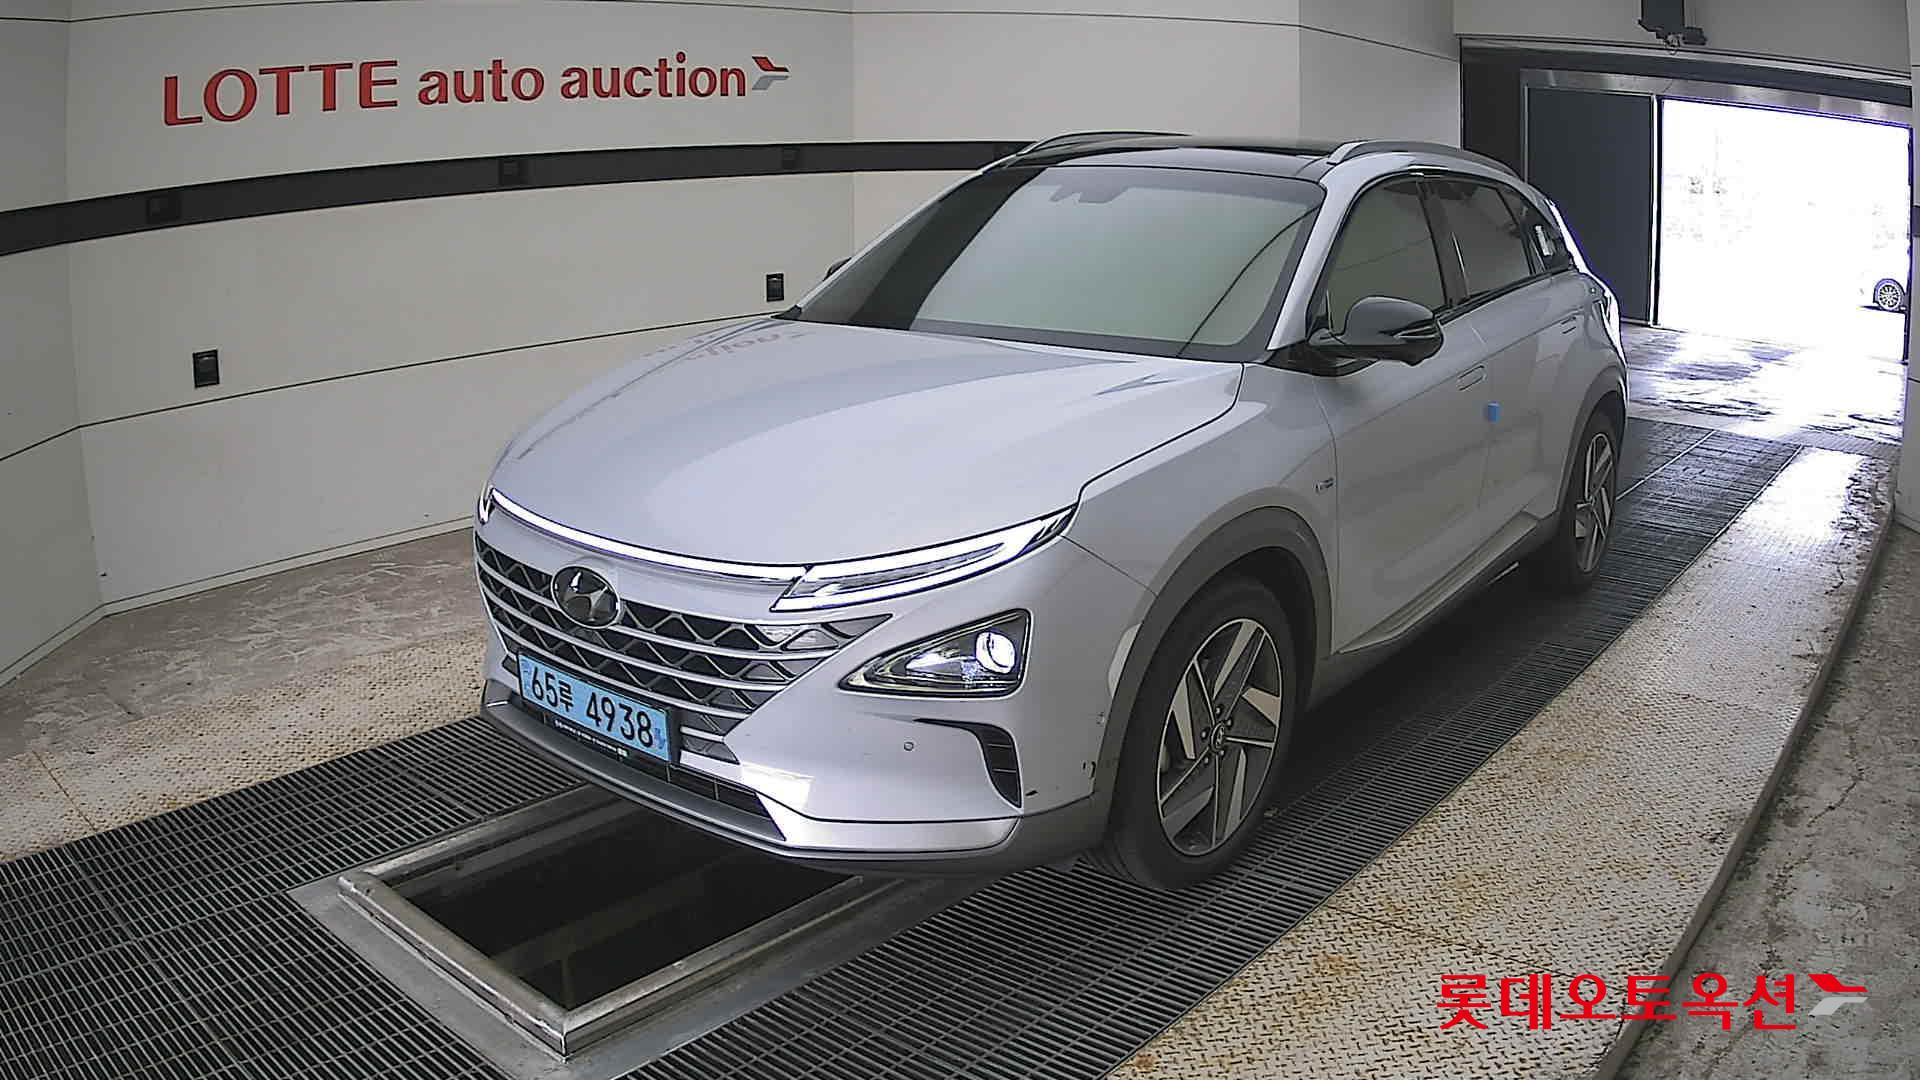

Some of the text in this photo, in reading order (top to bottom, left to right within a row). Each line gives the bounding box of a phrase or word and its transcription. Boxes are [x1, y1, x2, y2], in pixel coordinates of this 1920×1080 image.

[163, 51, 748, 127] LOTTE auto auction
[531, 666, 574, 713] 65루
[586, 691, 654, 748] 4938
